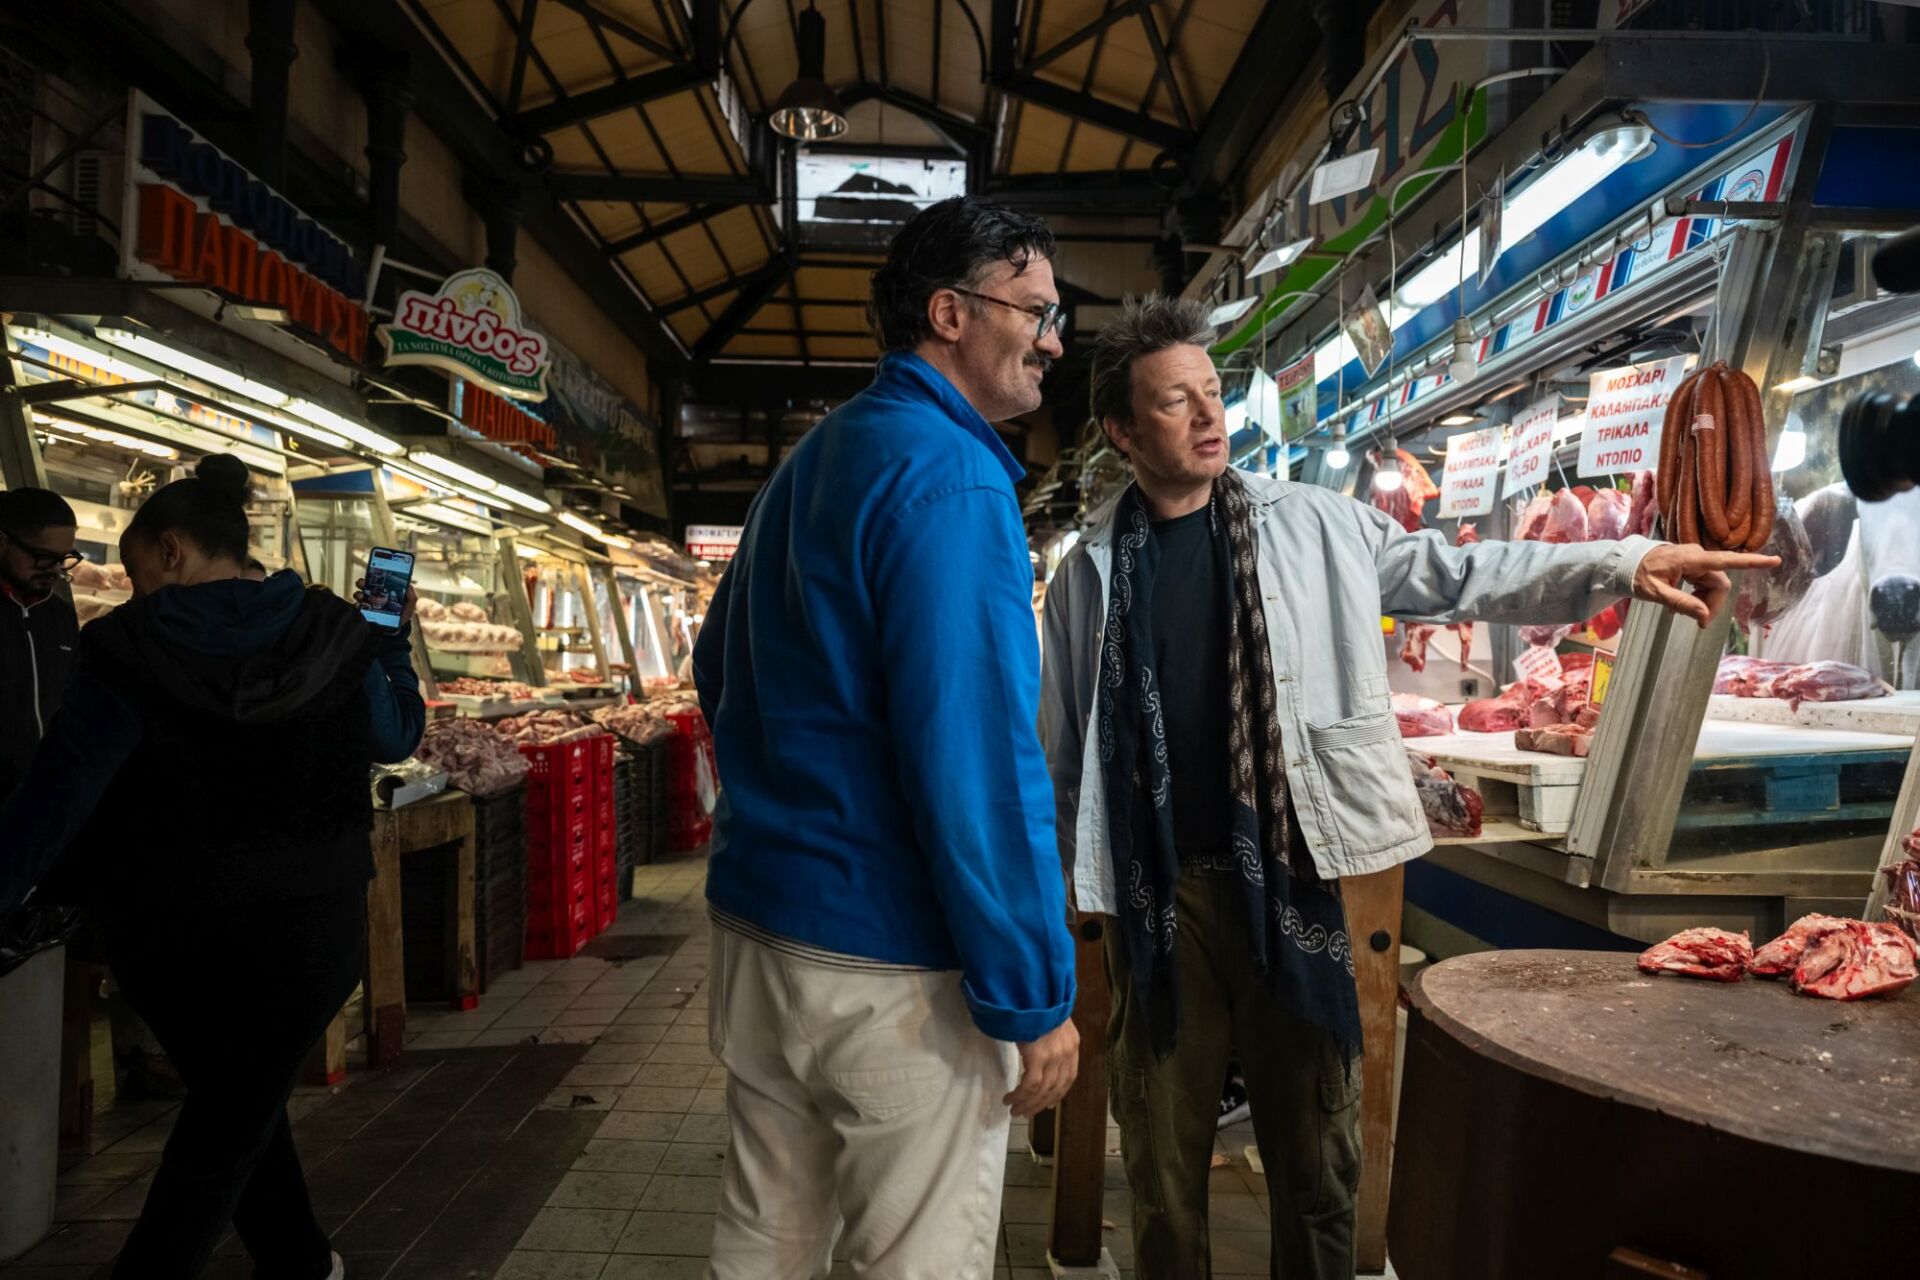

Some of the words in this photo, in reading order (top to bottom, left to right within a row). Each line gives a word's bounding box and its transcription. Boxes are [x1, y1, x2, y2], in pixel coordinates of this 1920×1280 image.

[1606, 368, 1666, 392] ΜΟΣΧΑΡΙ
[1597, 421, 1649, 442] ΤΡΙΚΑΛΑ
[1596, 448, 1642, 468] ΝΤΟΠΙΟ
